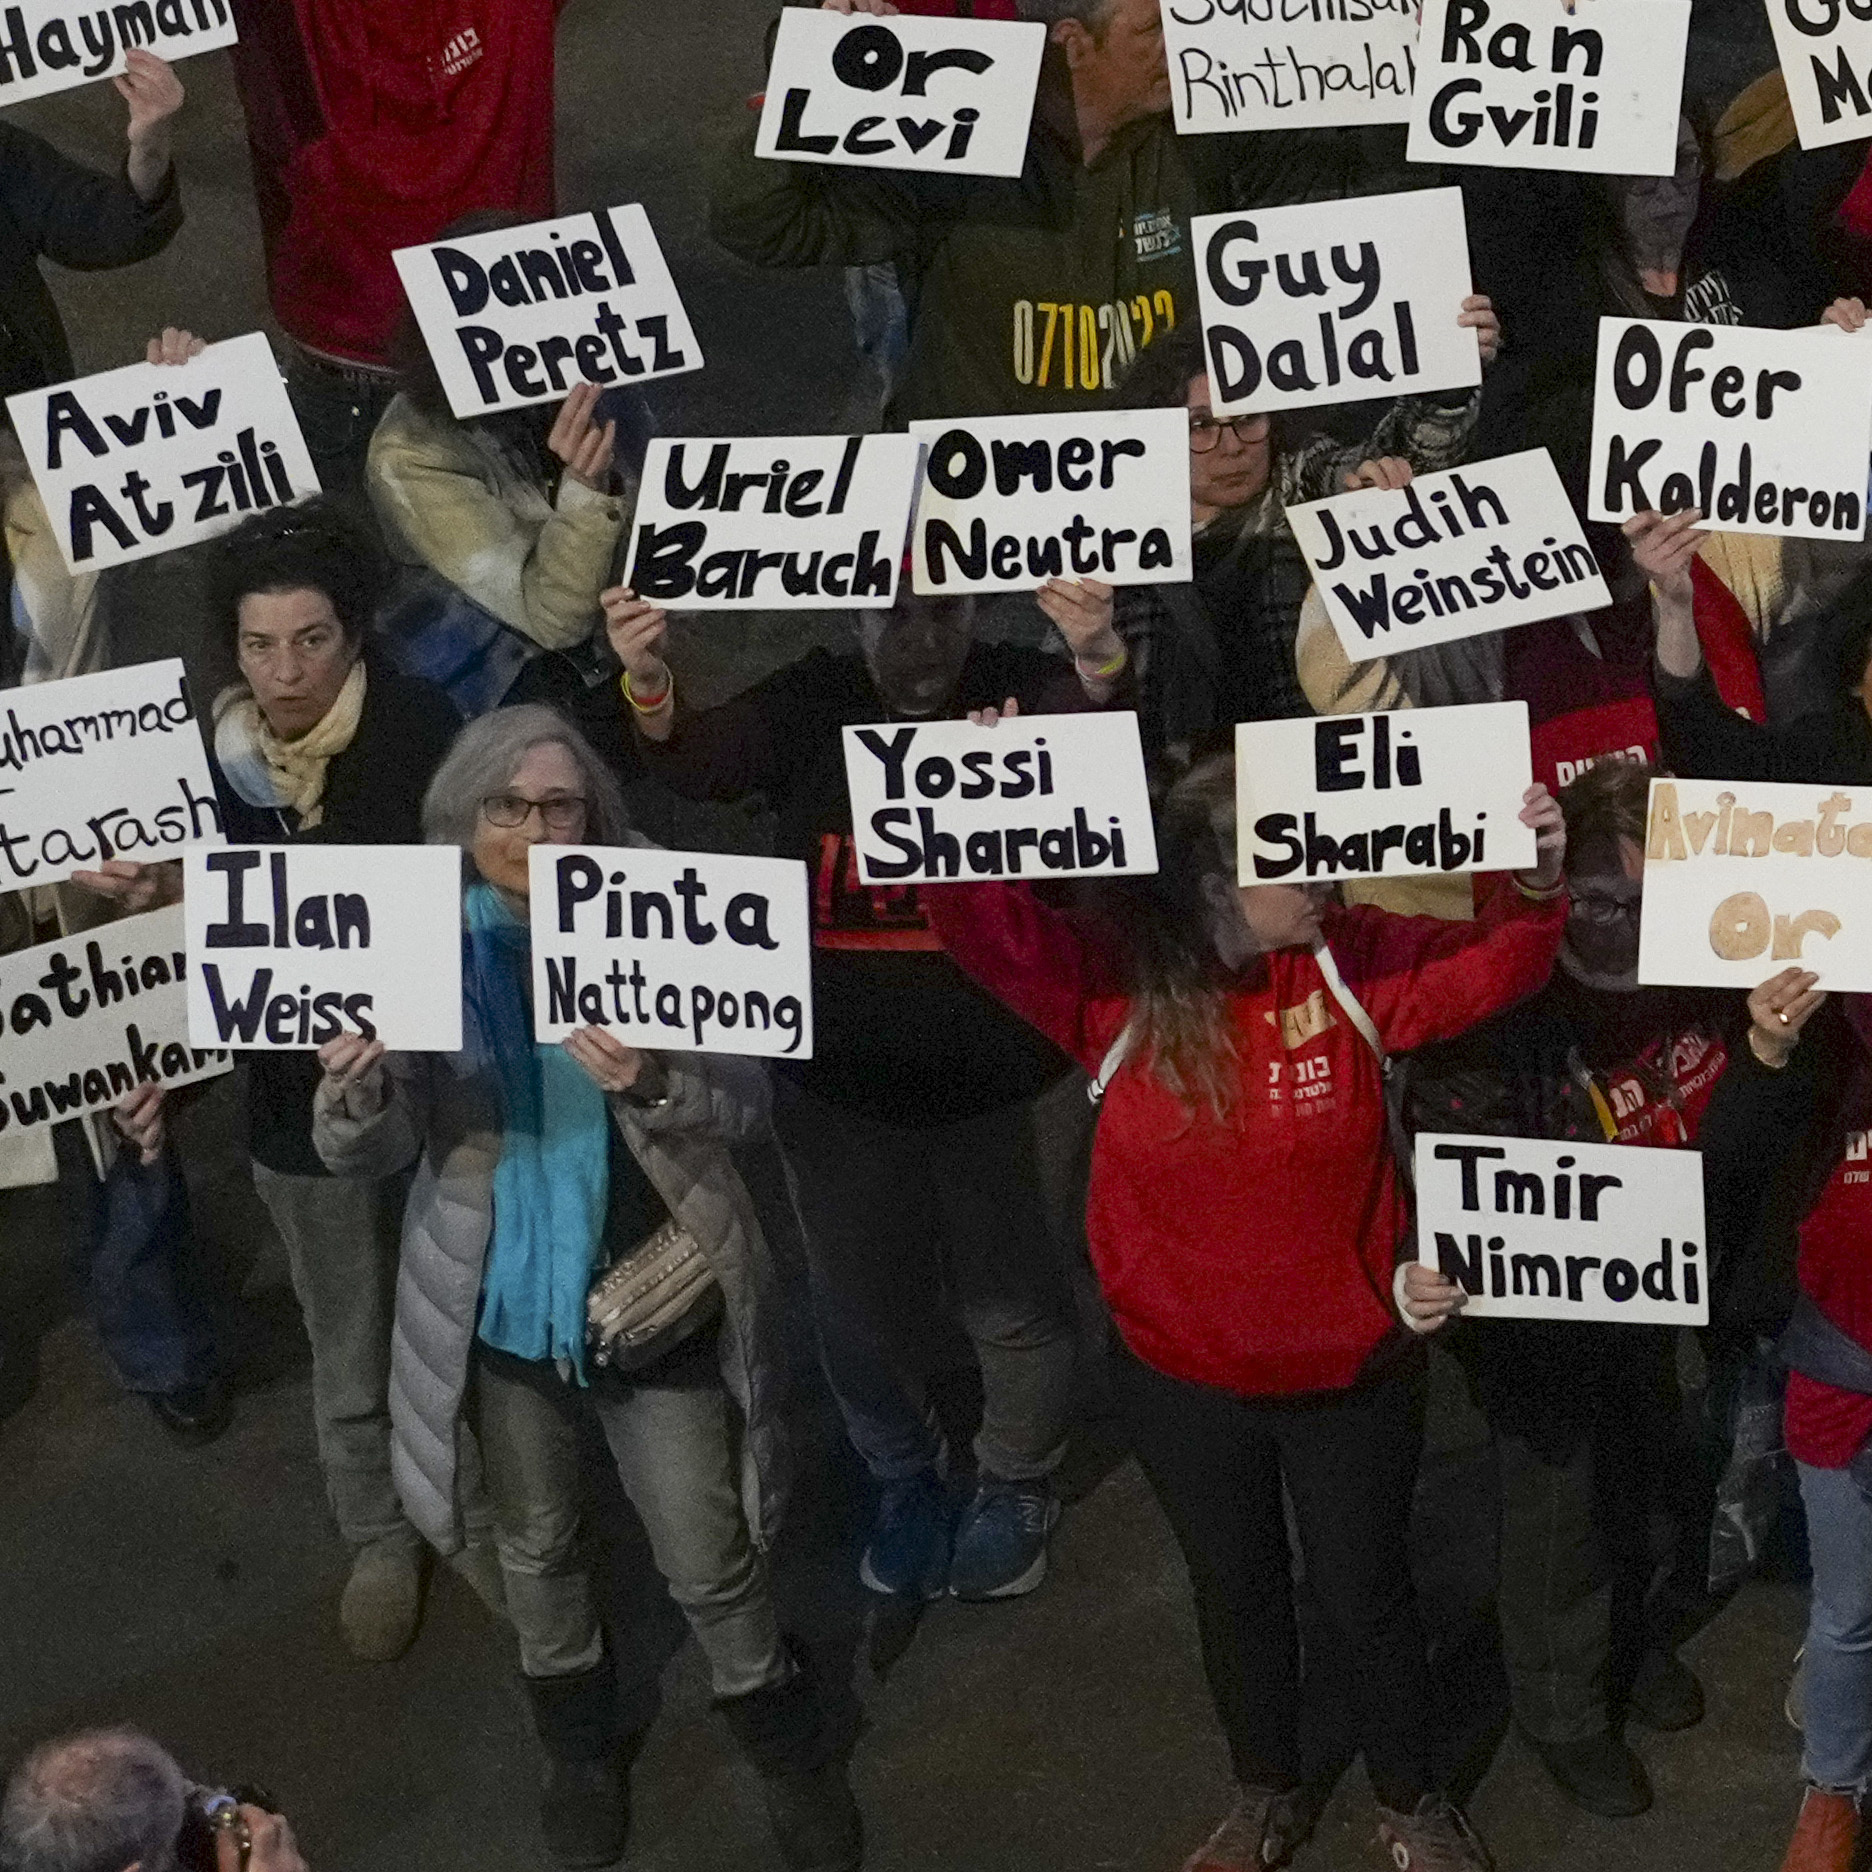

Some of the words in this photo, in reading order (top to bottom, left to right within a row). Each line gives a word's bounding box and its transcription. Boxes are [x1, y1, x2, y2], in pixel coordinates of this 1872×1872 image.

[831, 23, 996, 97] Or
[1428, 78, 1600, 151] Gvili
[431, 208, 638, 318] Daniel
[1205, 220, 1384, 320] Guy
[455, 302, 687, 408] Peretz
[1203, 301, 1423, 404] Dalal
[45, 385, 223, 471] Aviv
[924, 428, 1146, 501] Omer
[663, 436, 863, 516] Uriel
[1602, 434, 1862, 531] Kalderon
[923, 514, 1175, 586] Neutra
[1332, 536, 1602, 643] Weinstein
[854, 727, 1055, 802] Yossi
[1315, 716, 1424, 795] Eli
[865, 804, 1129, 883] Sharabi
[1252, 806, 1487, 880] Sharabi
[204, 849, 371, 952] Ilan
[555, 854, 782, 953] Pinta
[1708, 889, 1844, 964] Or
[201, 962, 379, 1046] Weiss
[544, 956, 804, 1054] Nattapong
[1433, 1142, 1624, 1224] Tmir
[1432, 1230, 1702, 1308] Nimrodi
